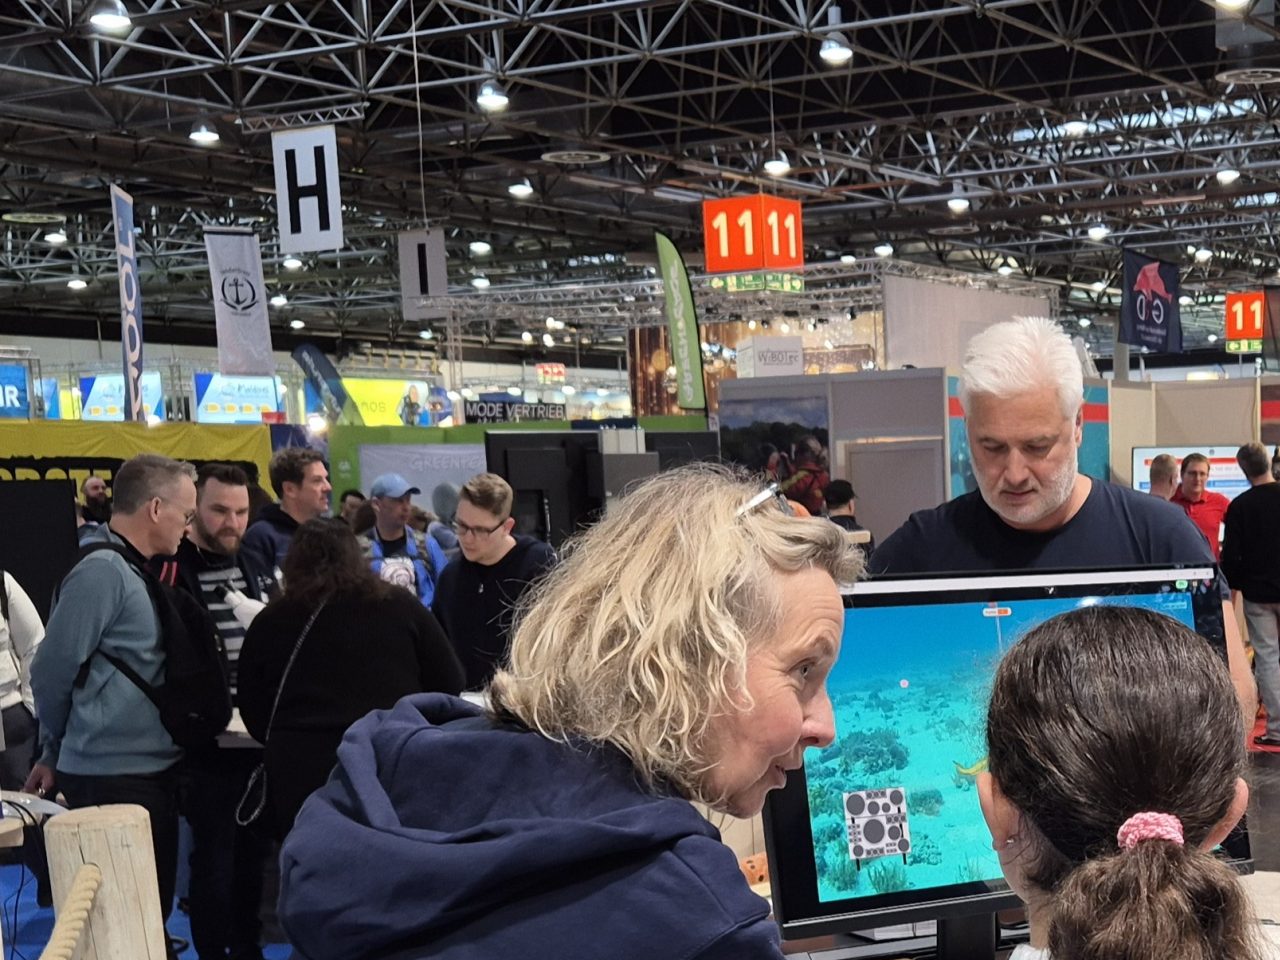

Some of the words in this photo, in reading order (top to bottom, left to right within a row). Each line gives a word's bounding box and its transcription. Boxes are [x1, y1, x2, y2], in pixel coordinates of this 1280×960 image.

[284, 145, 331, 235] H
[712, 209, 754, 258] 11
[767, 210, 797, 259] 11
[1231, 300, 1262, 331] 11
[465, 402, 503, 417] MODE
[505, 402, 564, 419] VERTRIEB
